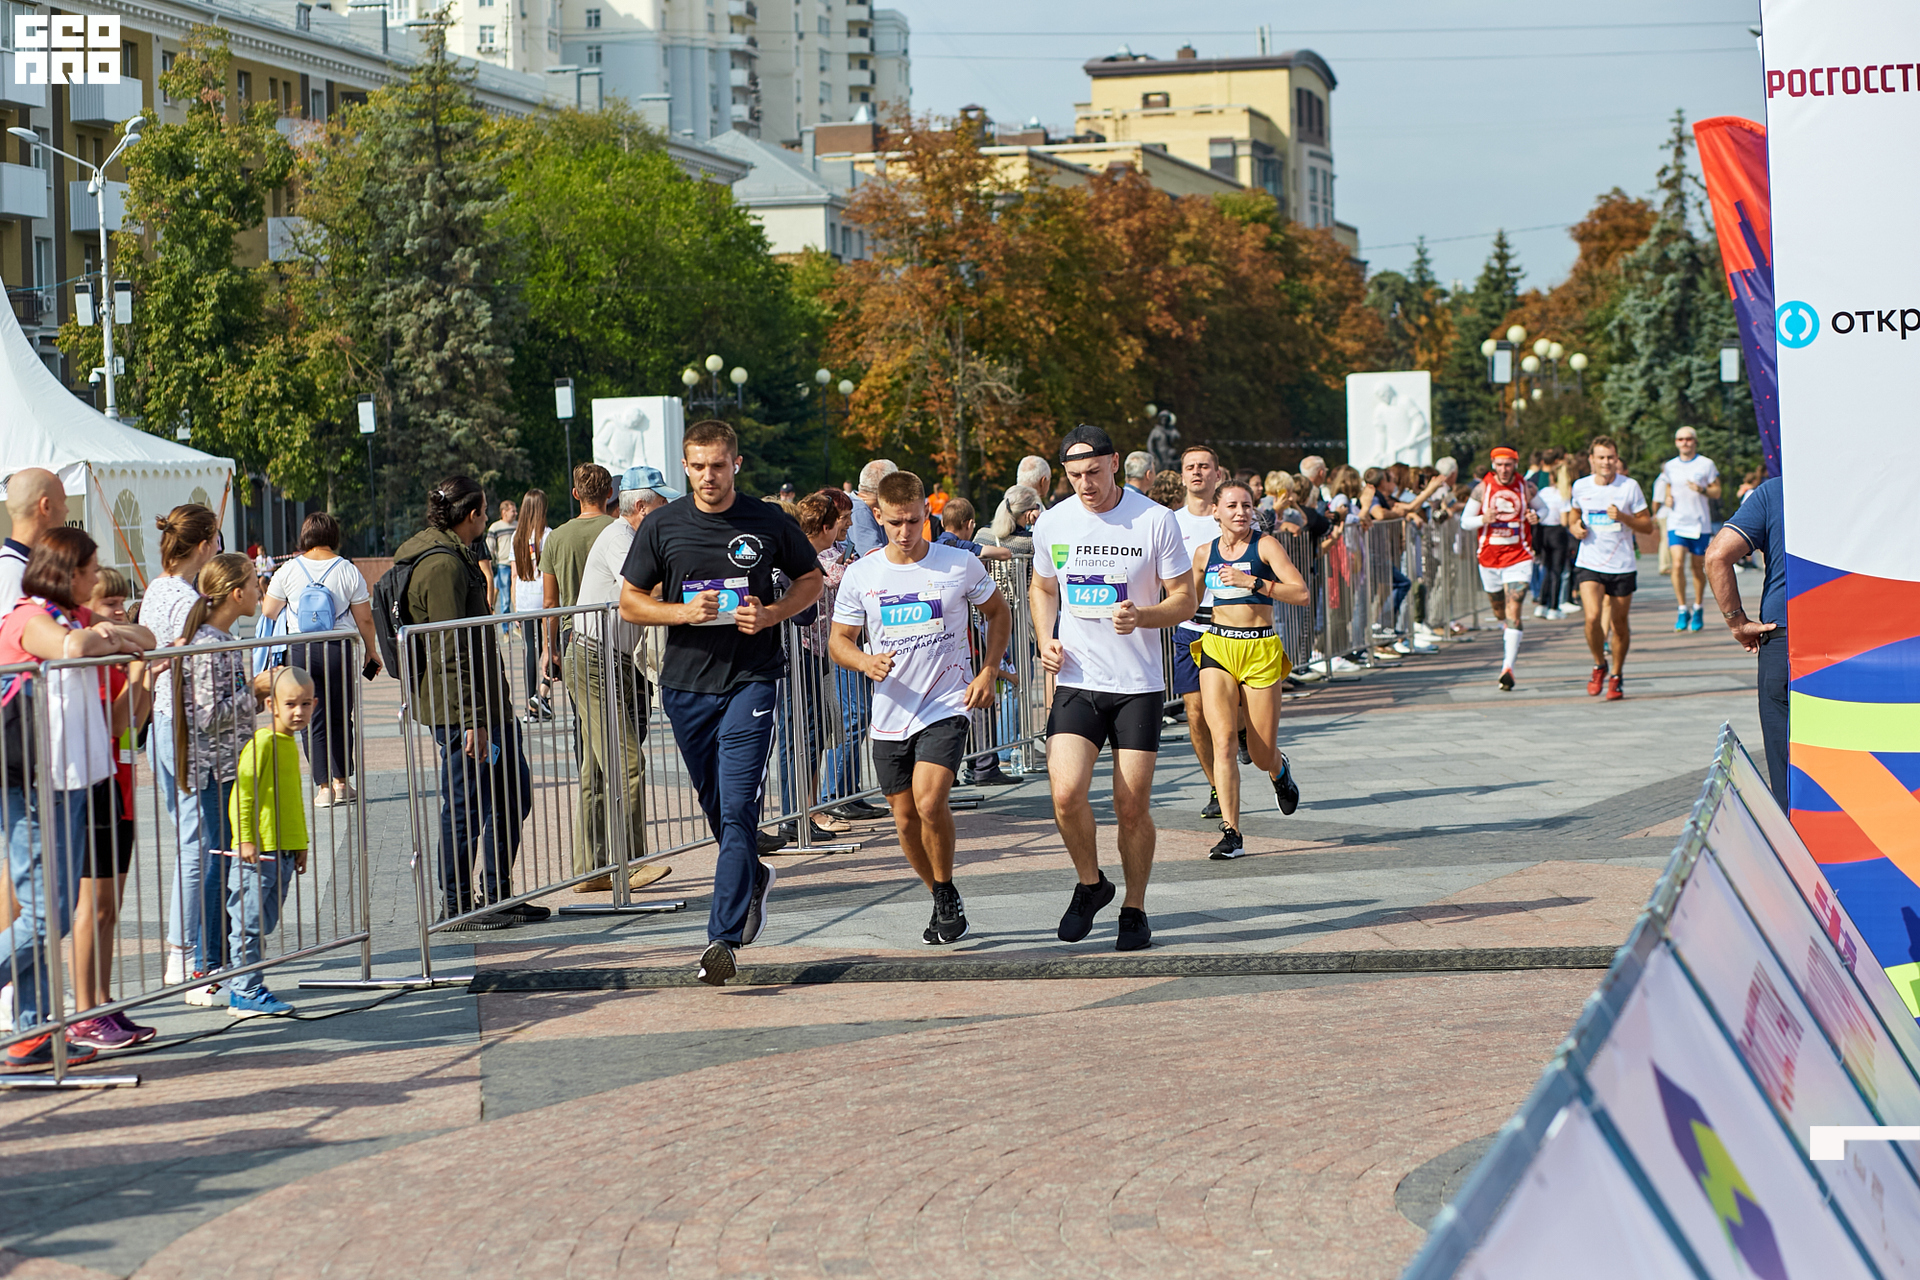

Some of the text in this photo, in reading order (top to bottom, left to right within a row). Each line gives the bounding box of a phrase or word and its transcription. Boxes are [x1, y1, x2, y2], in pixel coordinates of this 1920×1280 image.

[1767, 63, 1920, 98] РОСГОССТ
[1076, 545, 1143, 557] FREEDOM
[1074, 557, 1116, 567] finance
[1074, 588, 1110, 603] 1419
[889, 606, 923, 623] 1170
[1220, 628, 1260, 638] VERGO
[927, 641, 956, 660] 2021
